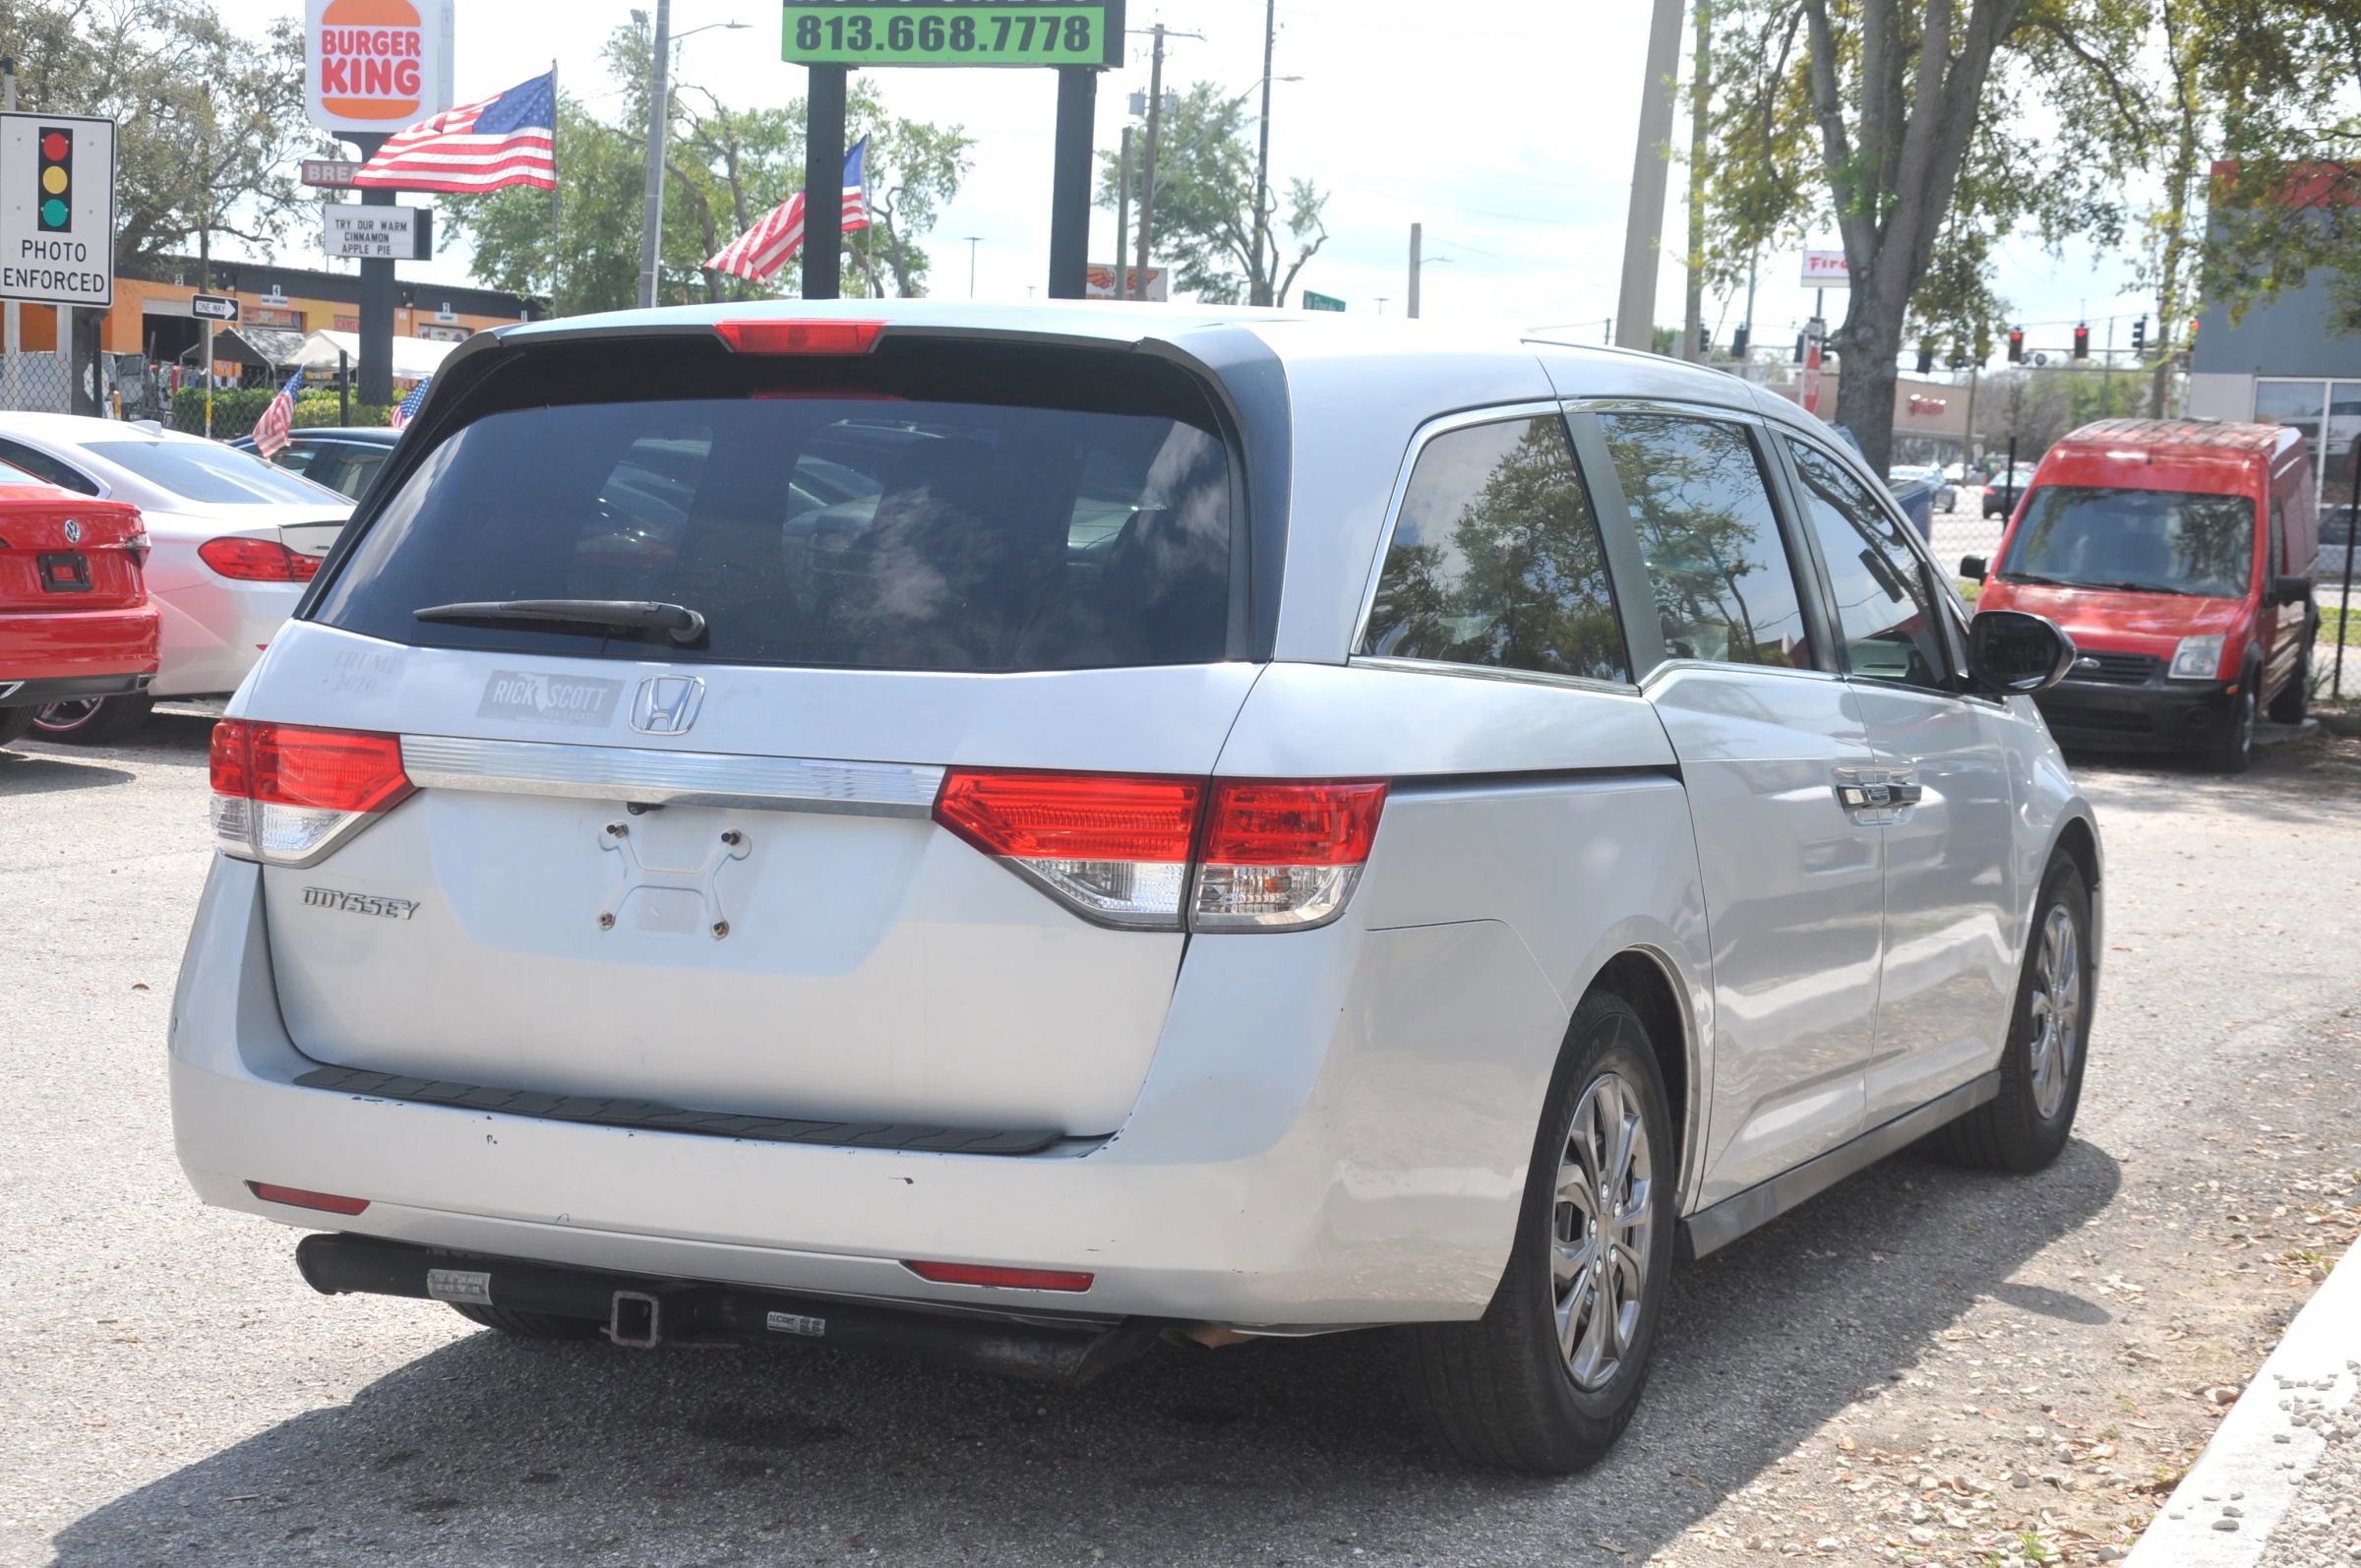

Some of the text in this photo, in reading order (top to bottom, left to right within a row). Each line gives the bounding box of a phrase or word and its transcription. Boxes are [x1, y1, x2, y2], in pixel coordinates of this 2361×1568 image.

[322, 30, 421, 57] BURGER
[796, 15, 1091, 51] 813.668.7778
[322, 57, 421, 95] KING
[335, 218, 407, 232] TRY OUR WARM
[344, 231, 390, 243] CINNAMON
[22, 239, 87, 263] PHOTO
[342, 243, 392, 256] APPLE PIE
[4, 268, 104, 293] ENFORCED
[492, 680, 608, 711] RICK SCOTT
[300, 886, 421, 921] ODYSSEY
